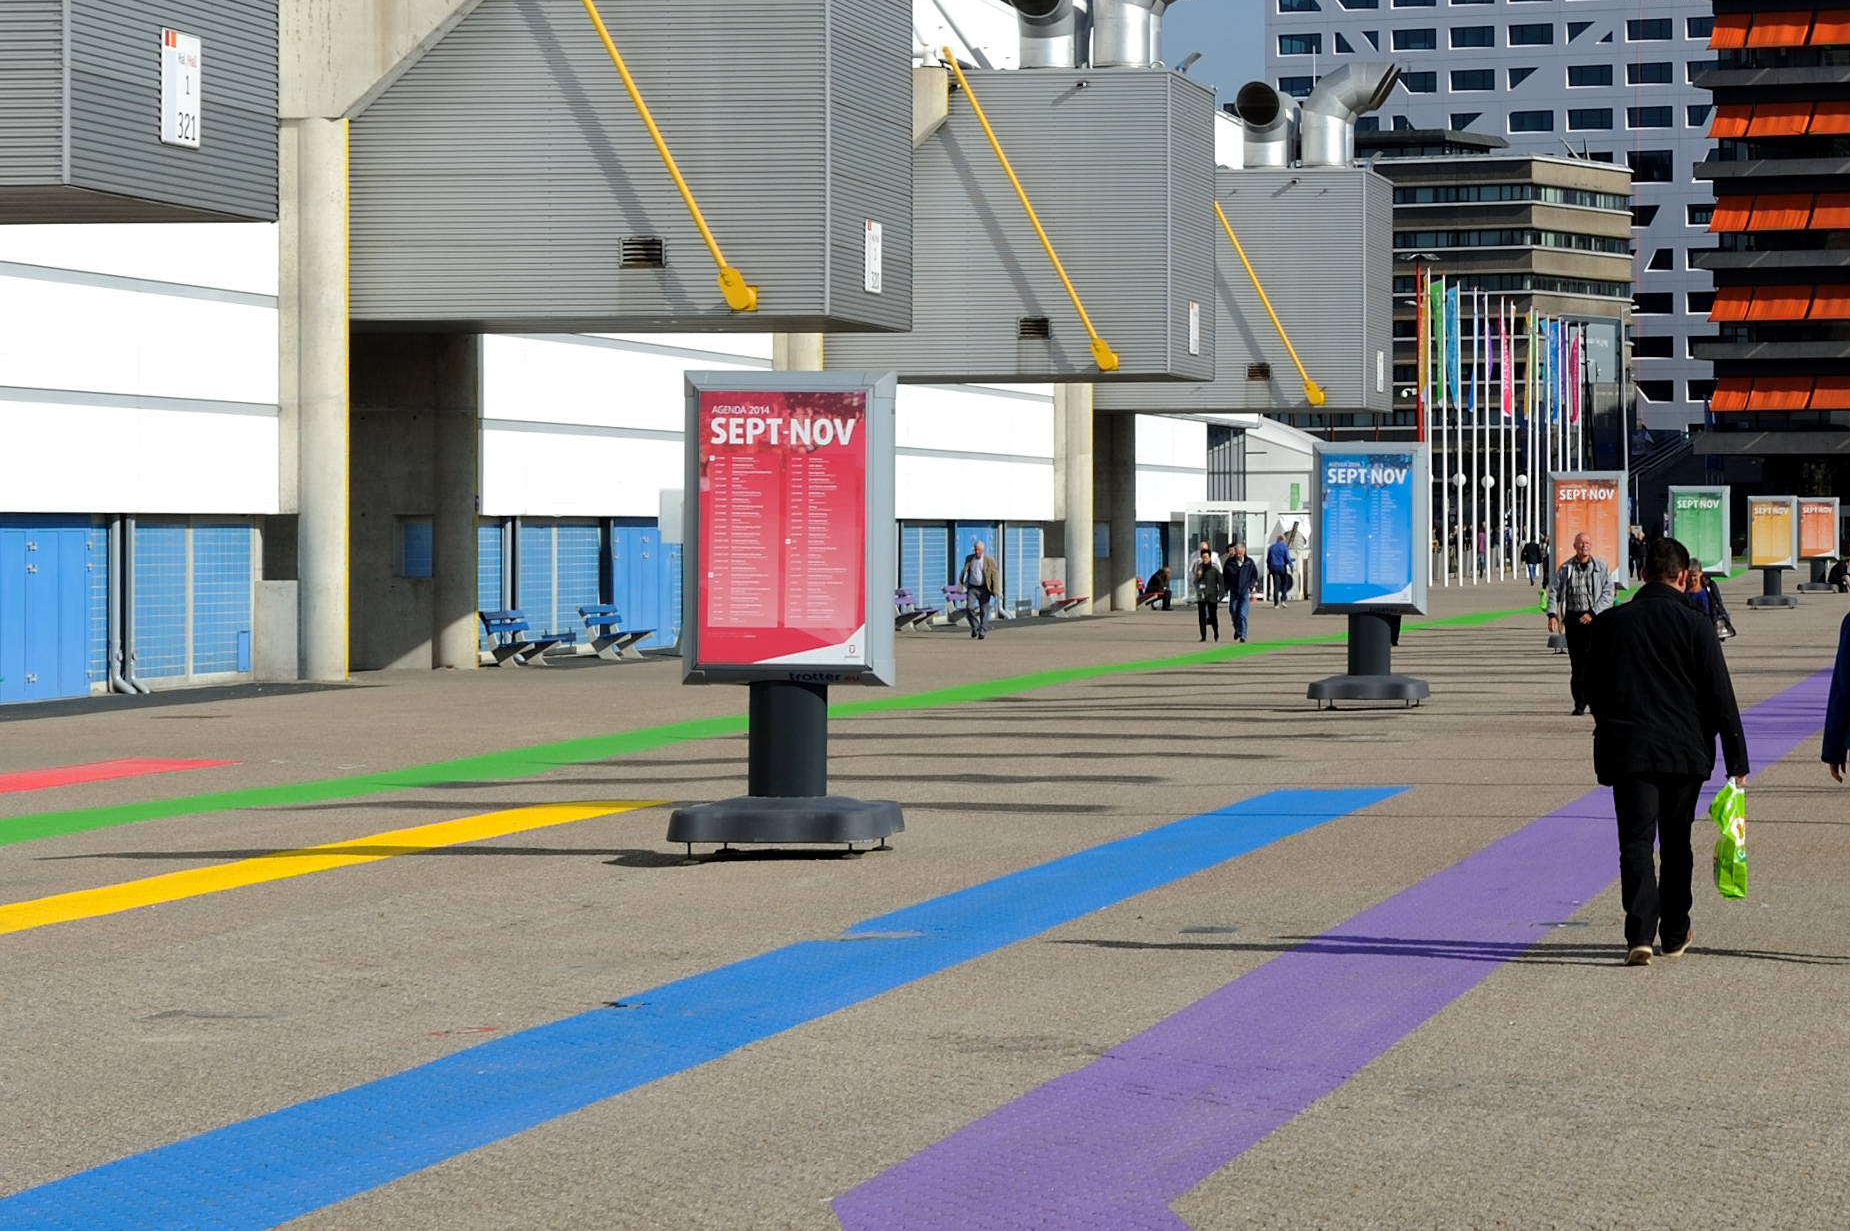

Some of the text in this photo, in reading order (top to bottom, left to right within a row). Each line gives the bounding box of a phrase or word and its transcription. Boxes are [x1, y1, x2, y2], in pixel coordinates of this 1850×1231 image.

[185, 75, 190, 95] 1
[178, 112, 196, 141] 321
[711, 405, 770, 415] AGENDA 2014
[710, 417, 856, 446] SEPT-NOV
[789, 672, 842, 681] trotter
